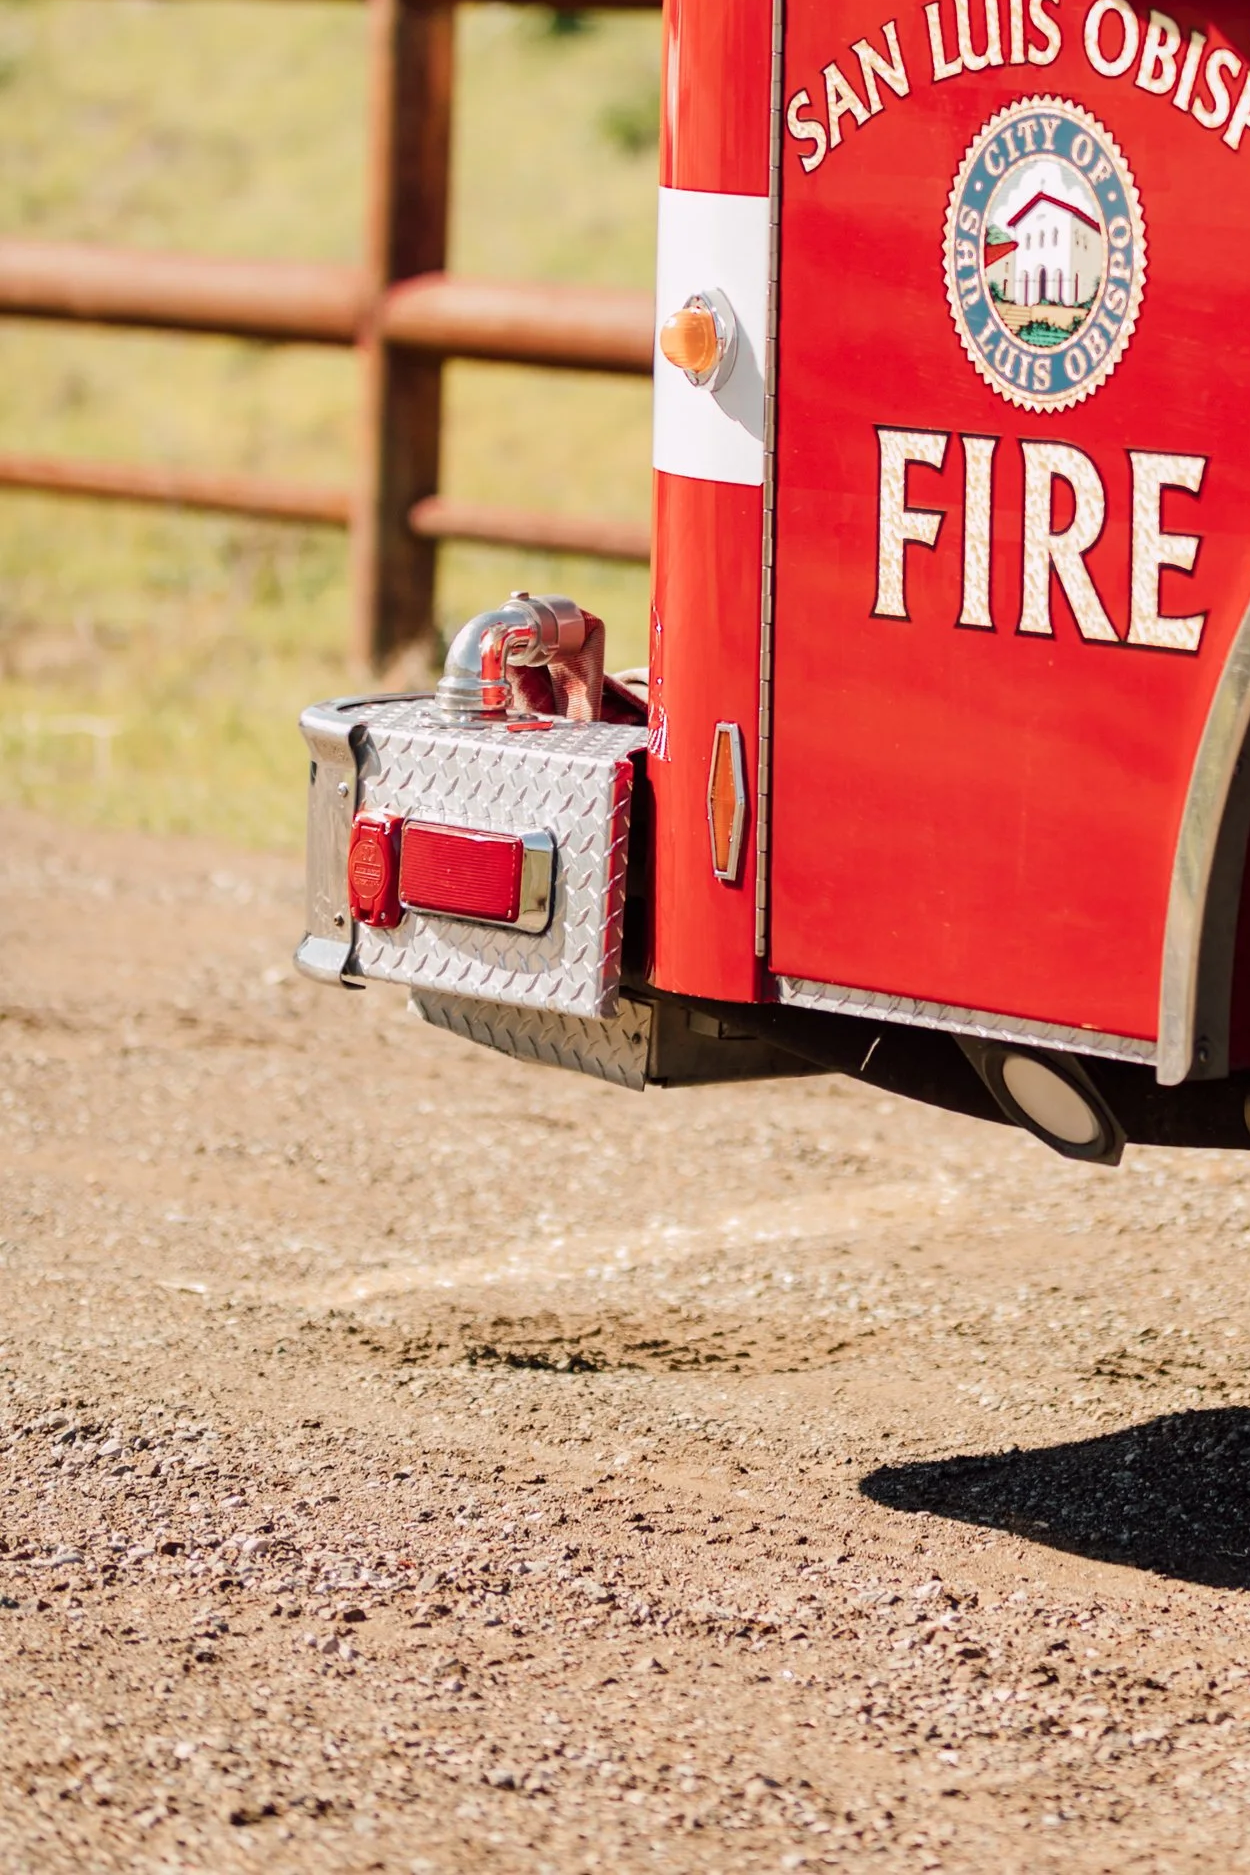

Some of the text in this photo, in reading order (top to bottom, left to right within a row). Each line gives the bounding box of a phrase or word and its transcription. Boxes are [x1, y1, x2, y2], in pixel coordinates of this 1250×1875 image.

[786, 21, 910, 173] SAN
[984, 117, 1112, 187] CITY OF
[975, 315, 1053, 391] LUIS
[1063, 215, 1132, 382] OBISPO
[869, 424, 1211, 653] FIRE
